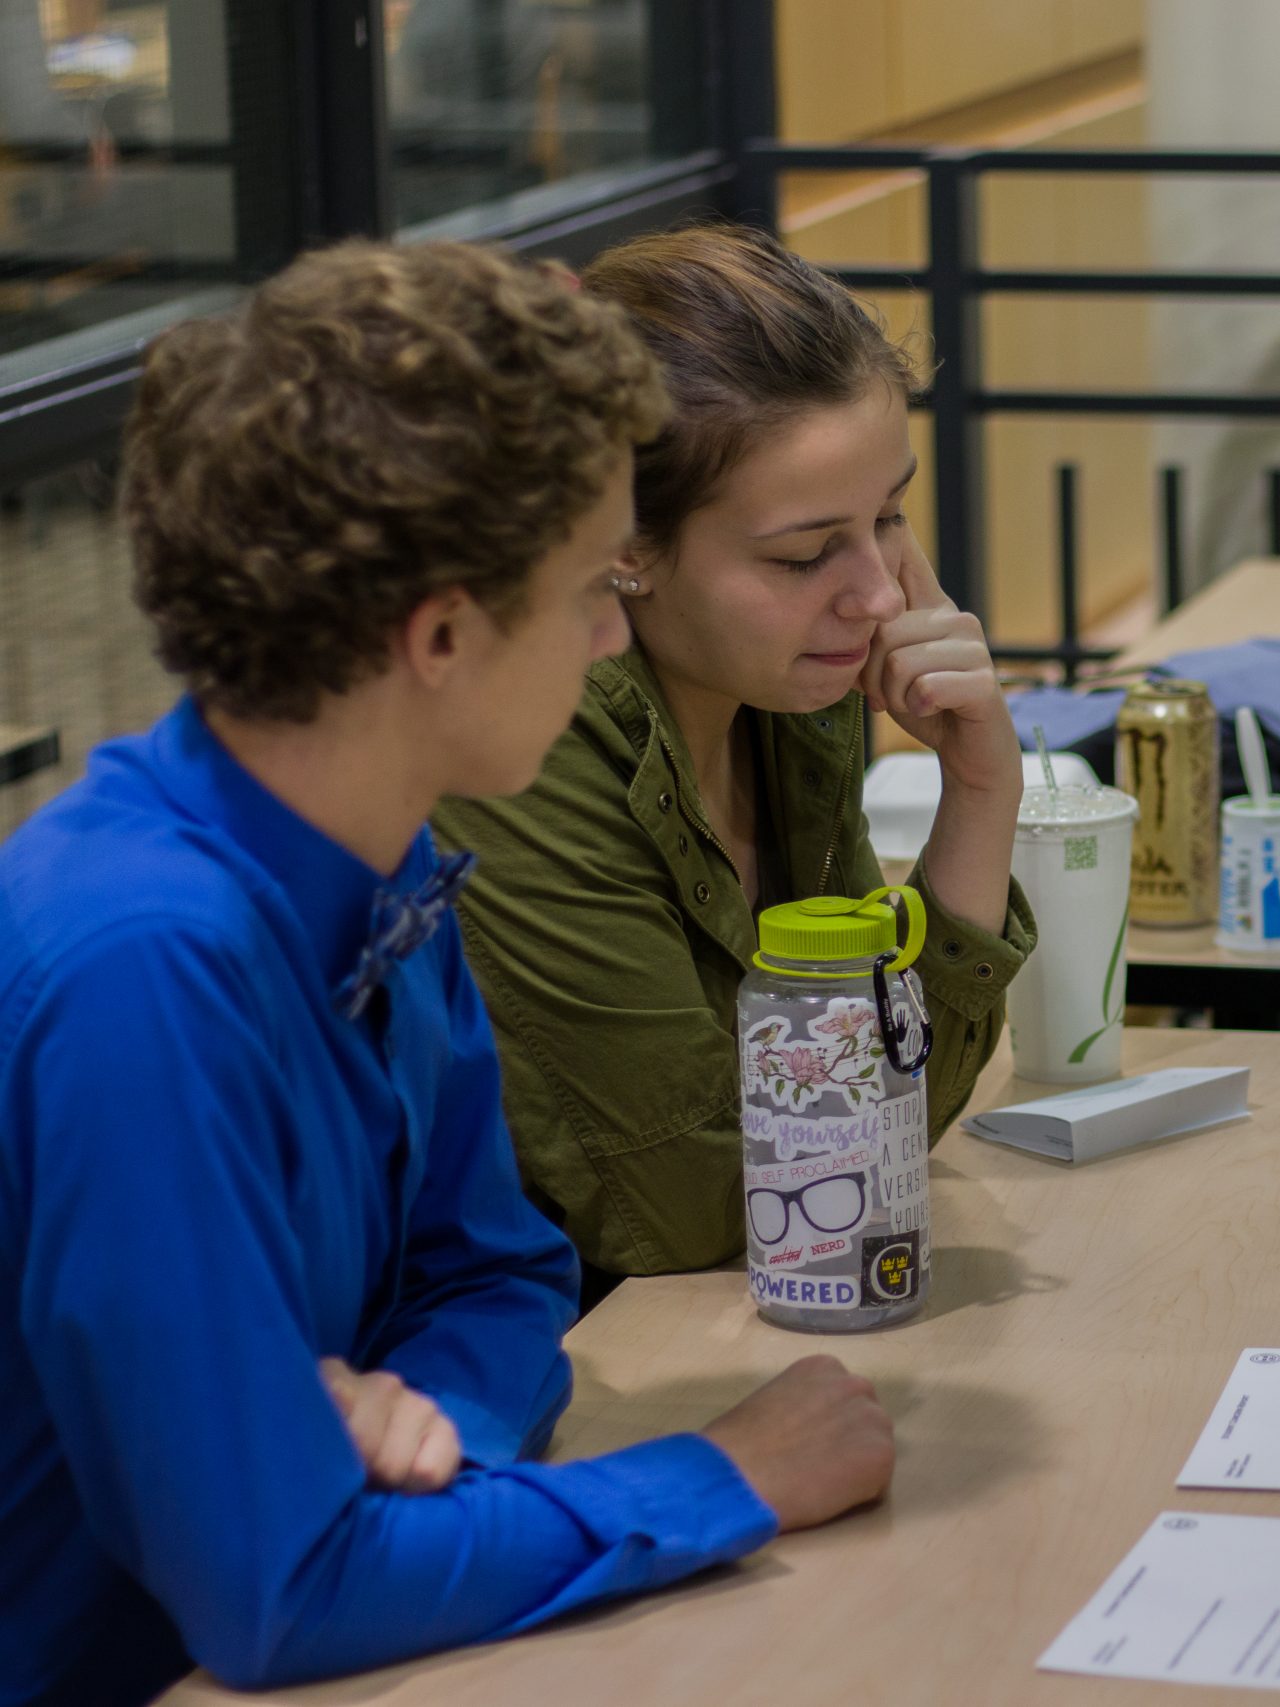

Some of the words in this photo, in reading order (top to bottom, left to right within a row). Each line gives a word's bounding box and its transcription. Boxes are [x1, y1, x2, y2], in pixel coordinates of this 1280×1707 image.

[883, 1097, 917, 1131] STOP
[741, 1110, 772, 1135] ove
[778, 1109, 880, 1158] yourself
[761, 1169, 784, 1185] SELF
[789, 1150, 870, 1181] PROCLAIMED
[809, 1239, 845, 1256] NERD
[748, 1265, 855, 1304] POWERED
[869, 1242, 915, 1300] G
